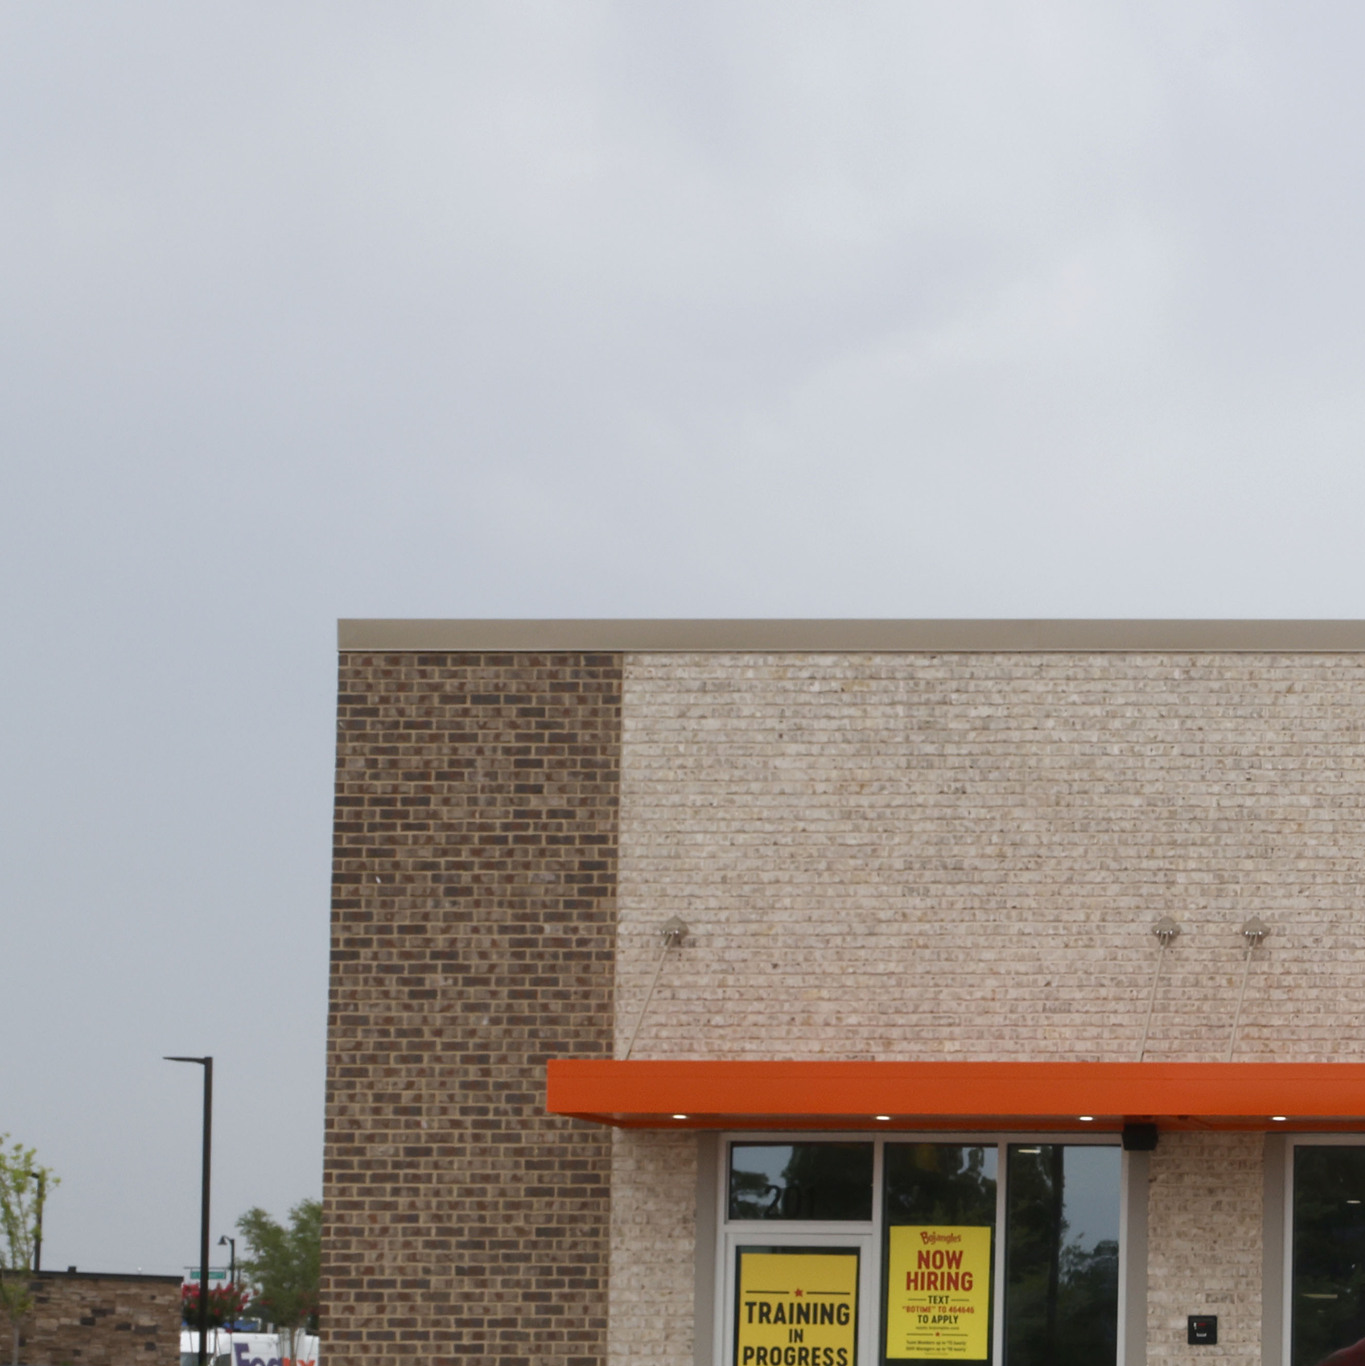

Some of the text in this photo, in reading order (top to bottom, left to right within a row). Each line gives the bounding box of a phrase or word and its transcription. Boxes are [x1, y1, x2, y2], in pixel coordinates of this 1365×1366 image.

[920, 1231, 961, 1245] Bojangles
[917, 1250, 963, 1270] NOW
[906, 1271, 974, 1291] HIRING
[928, 1295, 950, 1305] TEXT
[745, 1301, 850, 1325] TRAINING
[917, 1315, 959, 1324] TO APPLY
[789, 1329, 803, 1343] IN
